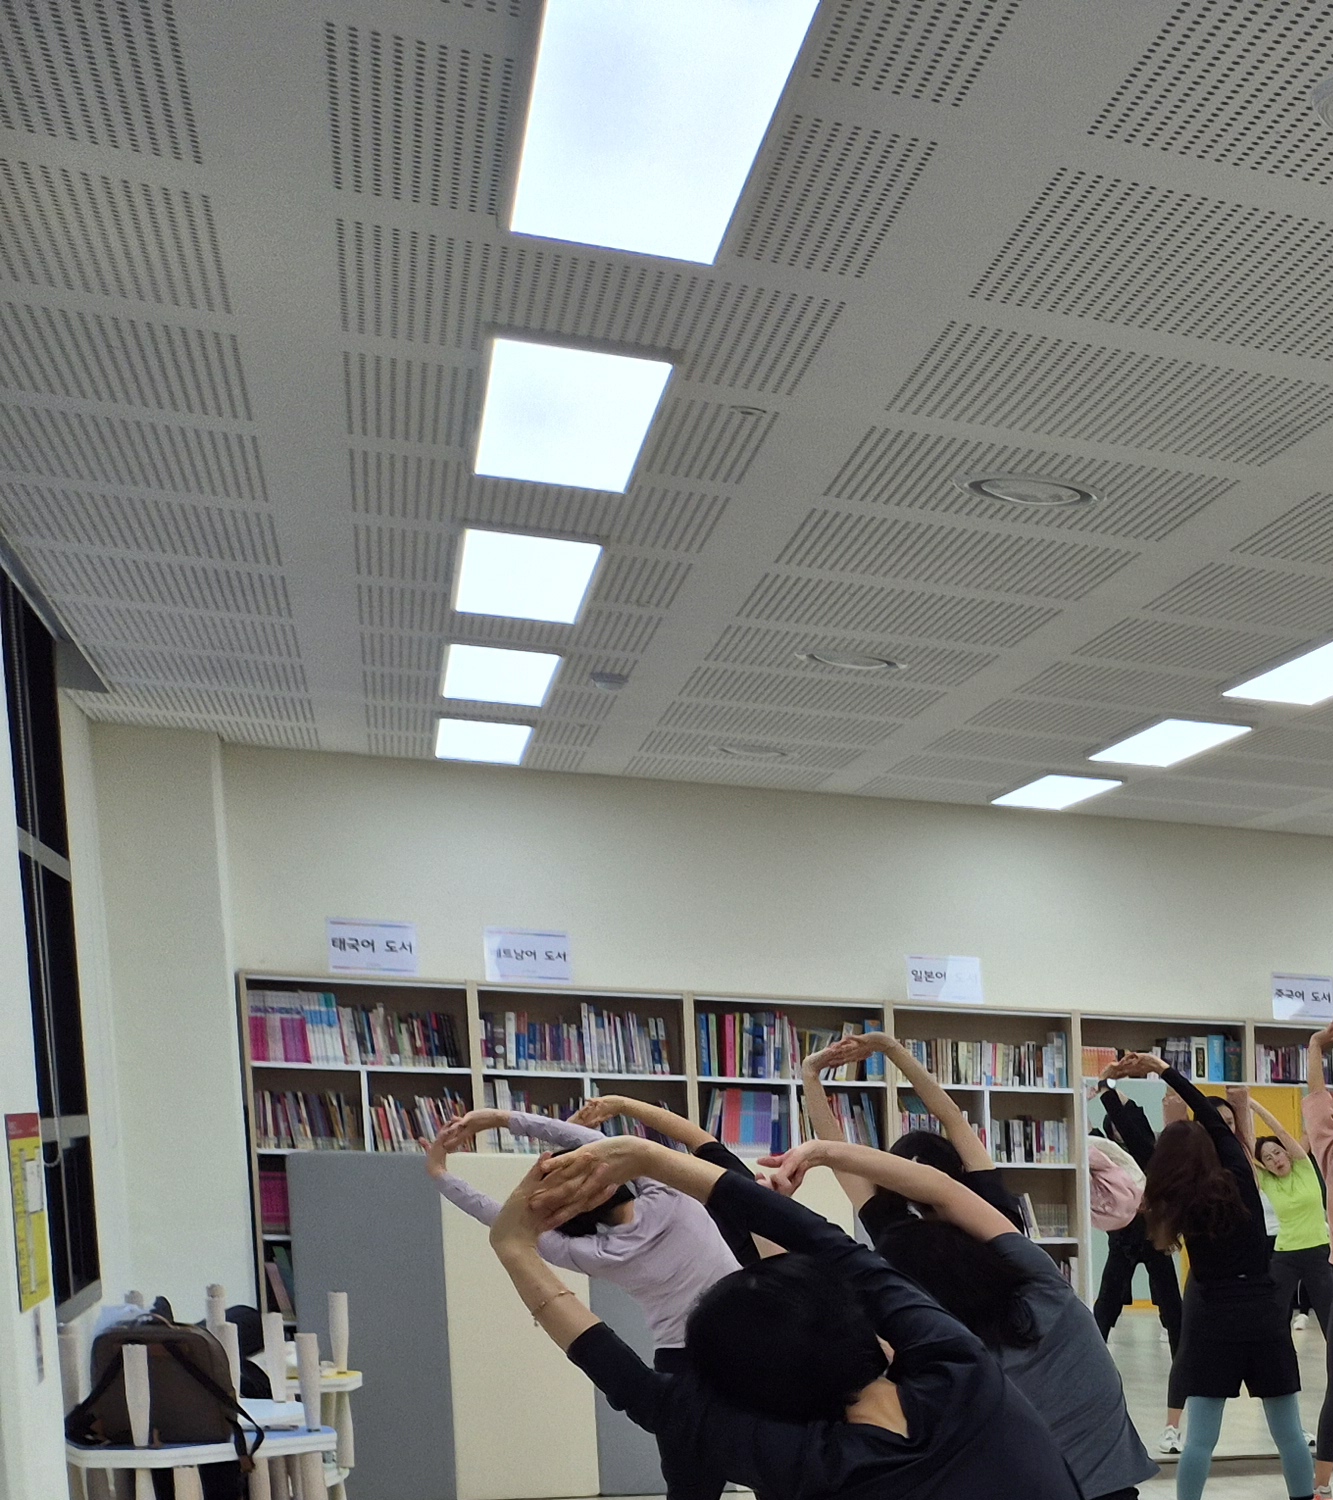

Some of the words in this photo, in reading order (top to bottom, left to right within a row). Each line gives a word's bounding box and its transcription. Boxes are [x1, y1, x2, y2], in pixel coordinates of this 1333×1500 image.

[331, 937, 376, 953] 태국어
[385, 940, 413, 955] 도서
[493, 948, 537, 961] 트남어
[544, 950, 567, 963] 도서
[911, 969, 947, 983] 일본어
[1311, 991, 1331, 1003] 도서
